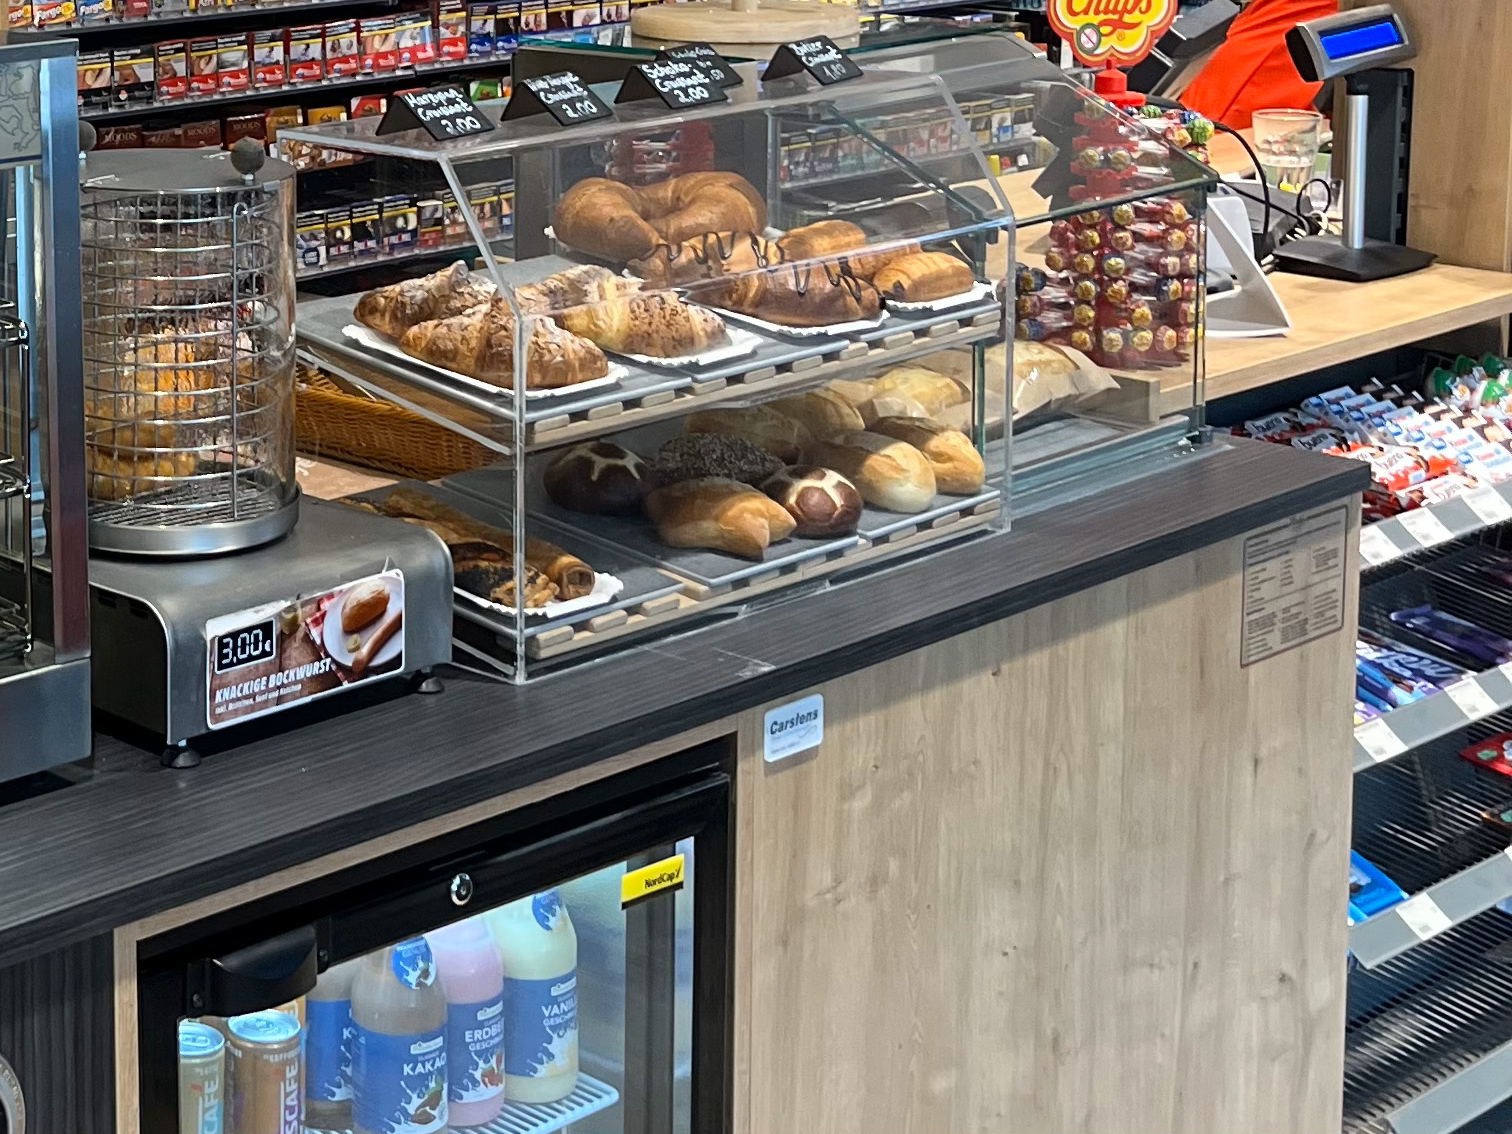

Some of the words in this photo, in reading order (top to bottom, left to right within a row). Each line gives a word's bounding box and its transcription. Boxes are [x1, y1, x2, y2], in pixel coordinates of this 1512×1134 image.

[1254, 416, 1283, 433] bueno
[1300, 432, 1329, 451] bueno
[215, 676, 267, 704] KNACKIGE
[268, 657, 333, 688] BOCKWURST
[770, 709, 819, 735] Carstens
[644, 871, 676, 889] NordCap
[541, 994, 577, 1017] VANIL
[464, 1022, 503, 1043] ERDBE
[402, 1051, 447, 1077] KAKAO
